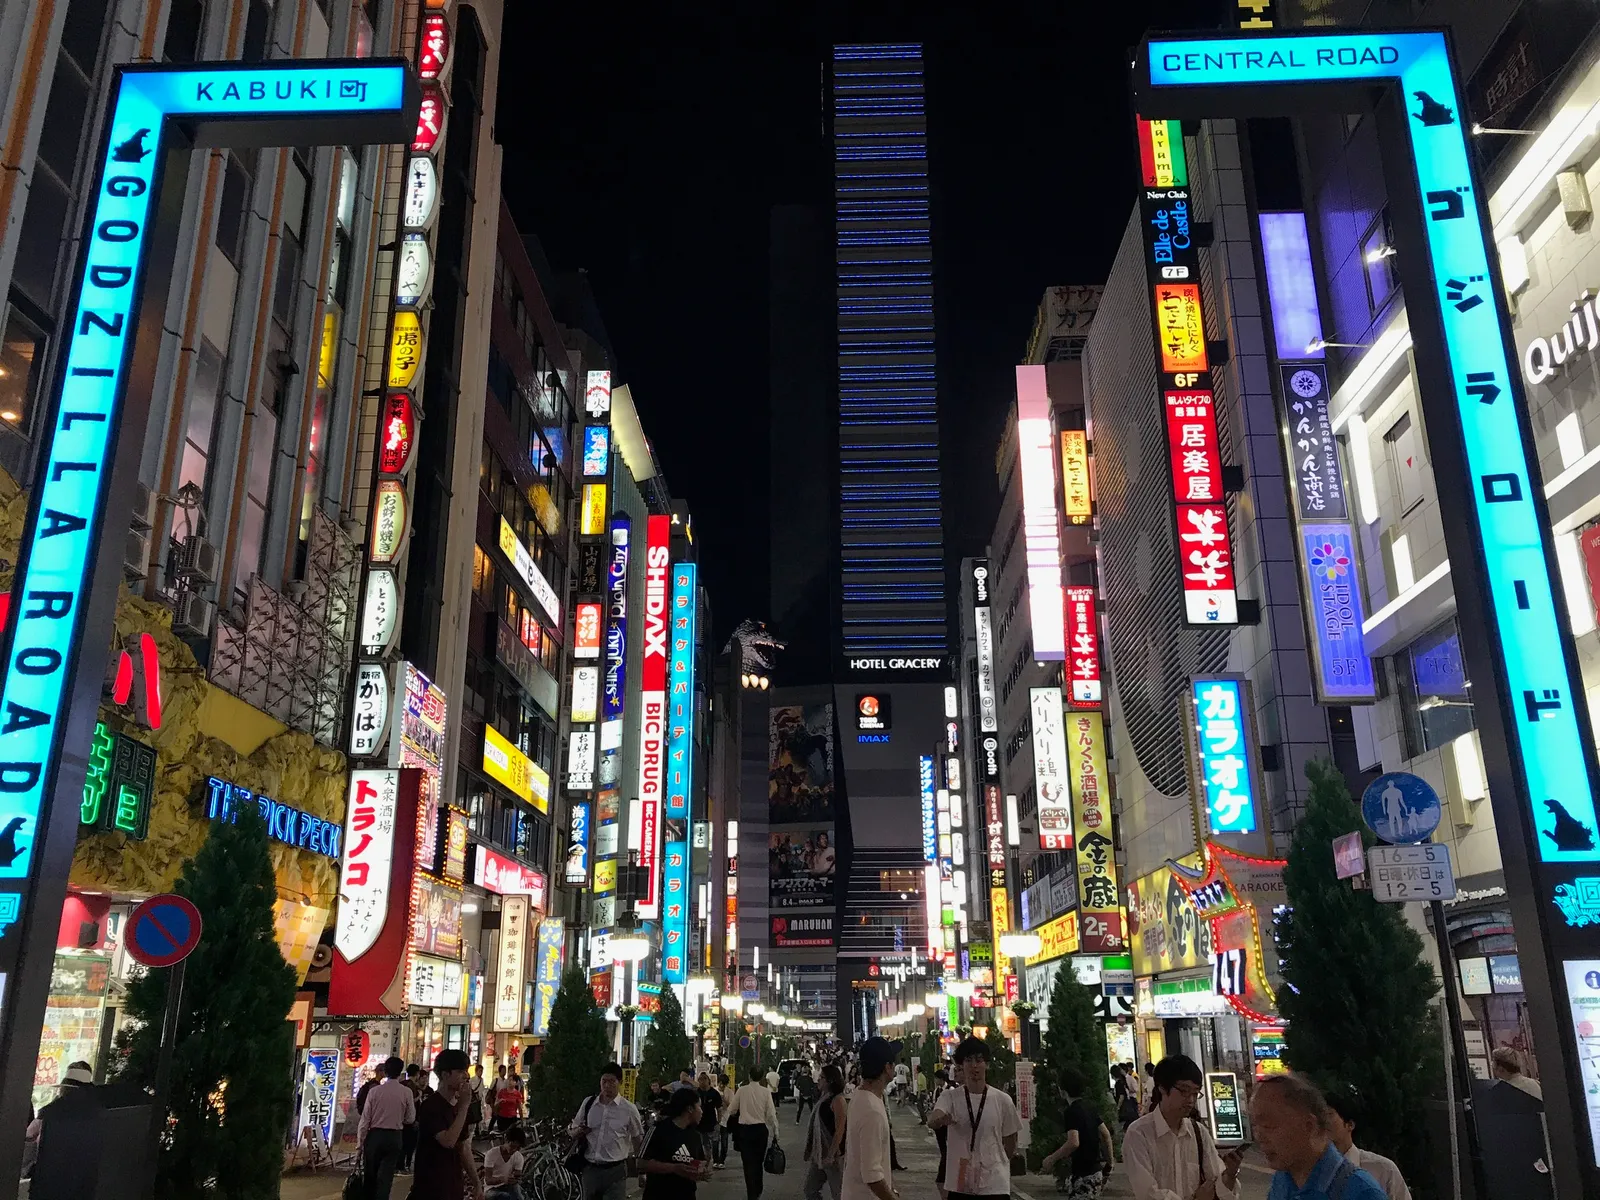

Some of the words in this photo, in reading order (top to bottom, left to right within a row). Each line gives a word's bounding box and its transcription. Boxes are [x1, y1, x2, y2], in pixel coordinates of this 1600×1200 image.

[1163, 48, 1308, 72] CENTRAL
[1317, 45, 1400, 67] ROAD
[1147, 191, 1166, 199] New
[1167, 190, 1188, 199] Club
[1149, 176, 1181, 184] カラム
[405, 215, 426, 225] 6F
[1151, 209, 1169, 231] de
[1169, 200, 1191, 249] Castle
[1155, 232, 1174, 263] Elle
[1166, 268, 1185, 277] 7F
[401, 296, 414, 304] 5F
[1183, 288, 1200, 353] 炭火焼だいにんぐ
[1523, 287, 1600, 386] Quij
[39, 175, 147, 540] GODZILLA
[395, 332, 418, 370] 虎の子
[1174, 373, 1199, 387] 6F
[1167, 395, 1212, 405] 新しいタイプの
[1180, 424, 1214, 500] 居楽屋
[1291, 401, 1327, 512] かんかん商店
[1426, 186, 1562, 722] ゴジラロード
[378, 493, 397, 554] お好み焼き
[1072, 515, 1086, 524] 6F
[973, 566, 988, 601] Booth
[645, 545, 670, 658] SHIDAX
[1075, 602, 1088, 634] 居楽屋
[1319, 583, 1342, 641] STAGE
[1335, 583, 1355, 632] IDOL
[365, 645, 381, 655] 1F
[850, 658, 888, 669] HOTEL
[888, 658, 941, 669] GRACERY
[1331, 657, 1359, 677] 5F
[0, 590, 74, 795] ROAD
[361, 671, 381, 680] 新宿
[671, 574, 689, 808] カラオケ&パーティー館
[645, 702, 661, 734] BIC
[356, 737, 373, 748] B1
[858, 735, 889, 743] IMAX
[983, 737, 998, 775] Booth
[1202, 685, 1250, 826] カラオケ
[643, 742, 661, 795] DRUG
[1077, 717, 1100, 808] きんくら酒場
[208, 777, 253, 825] TH
[299, 812, 341, 859] PECK
[376, 772, 397, 836] 大衆酒場
[645, 802, 654, 818] BIC
[346, 779, 378, 887] トラノコ
[571, 804, 587, 843] 海の家
[1045, 835, 1066, 848] B1
[771, 878, 834, 890] トランスフォーマー
[991, 869, 1005, 878] 4F
[991, 877, 1005, 886] 3F
[1079, 831, 1118, 909] 金の蔵
[341, 896, 366, 945] やきとん
[360, 887, 383, 934] やきとり
[665, 853, 682, 971] カラオケ館
[790, 918, 832, 931] MARUHAN
[1085, 917, 1108, 937] 2F
[1105, 972, 1132, 980] FamilyMart
[1207, 947, 1247, 997] 747
